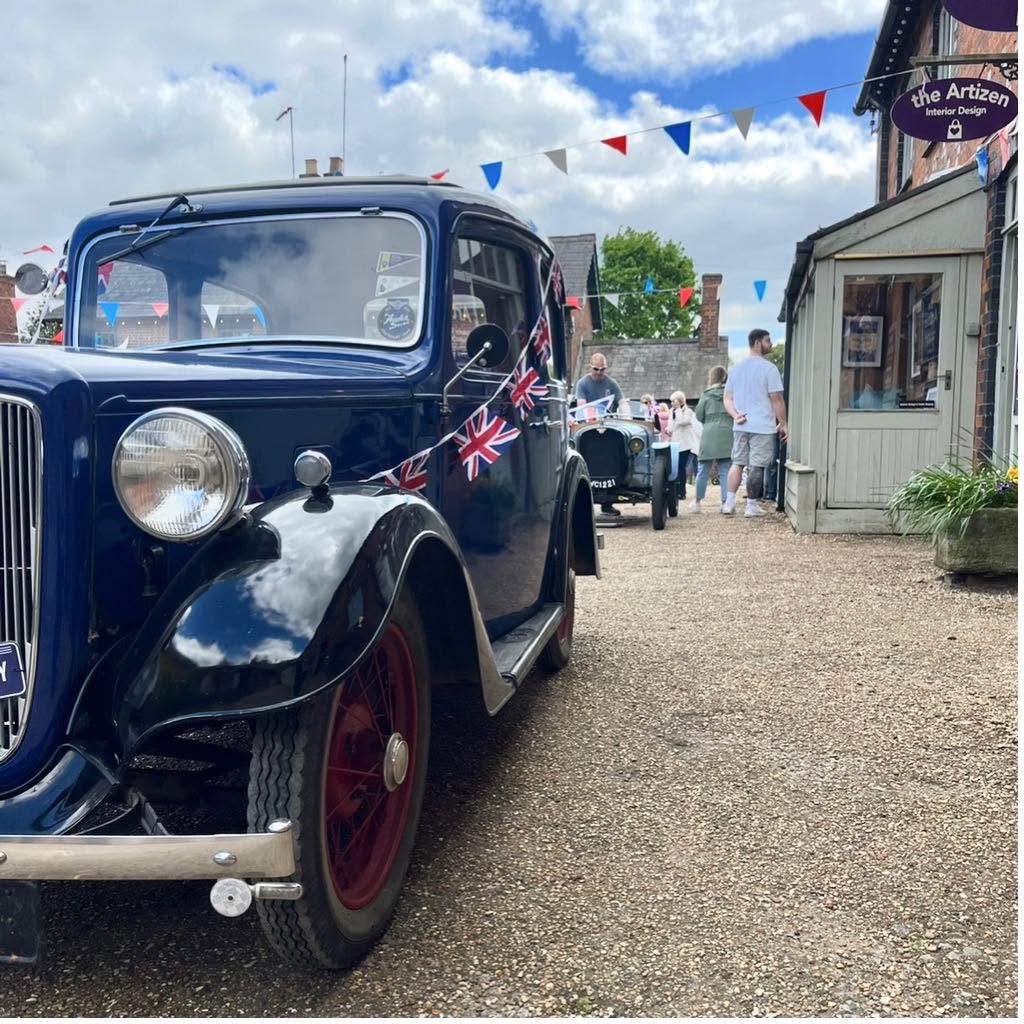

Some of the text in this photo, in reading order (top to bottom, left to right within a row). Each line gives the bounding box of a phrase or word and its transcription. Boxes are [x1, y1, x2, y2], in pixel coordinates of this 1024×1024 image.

[911, 82, 1010, 109] the Artizen
[926, 106, 987, 117] Interior Design
